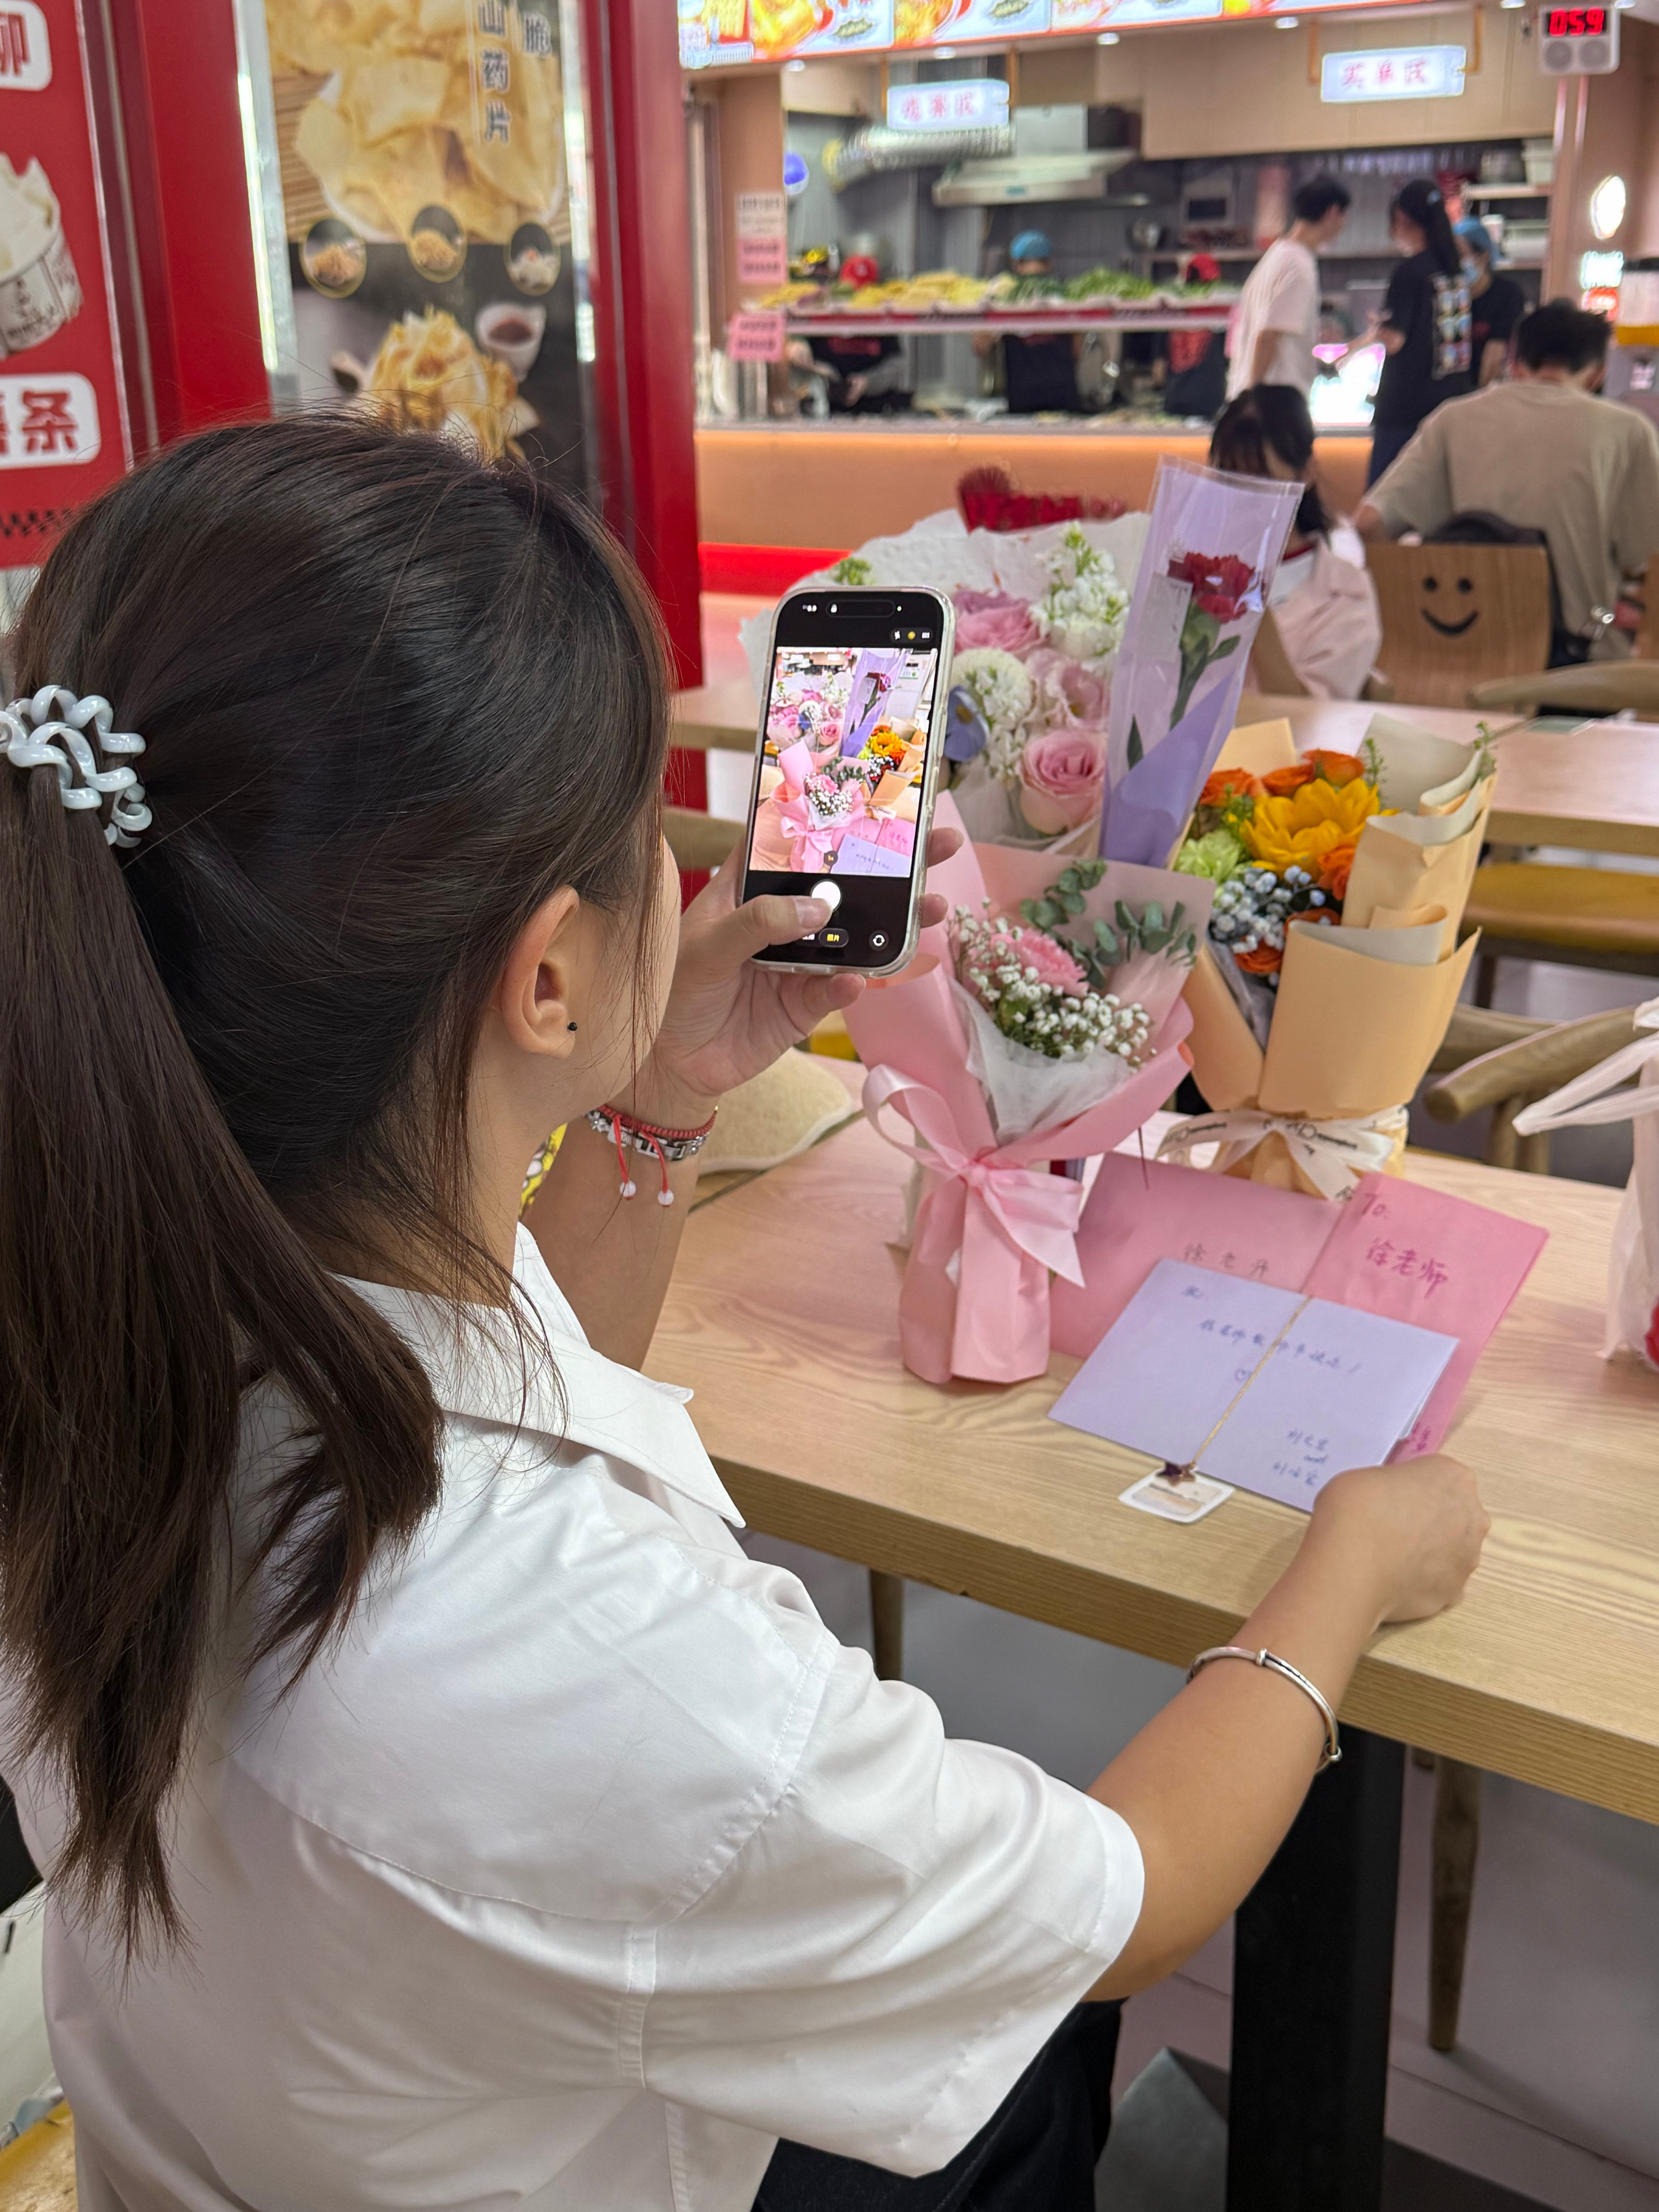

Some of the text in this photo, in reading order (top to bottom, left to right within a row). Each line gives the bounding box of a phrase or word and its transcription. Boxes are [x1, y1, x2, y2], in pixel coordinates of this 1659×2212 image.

[0, 390, 80, 455] 条
[1183, 1242, 1269, 1278] 徐老师
[1365, 1237, 1449, 1299] 徐老师
